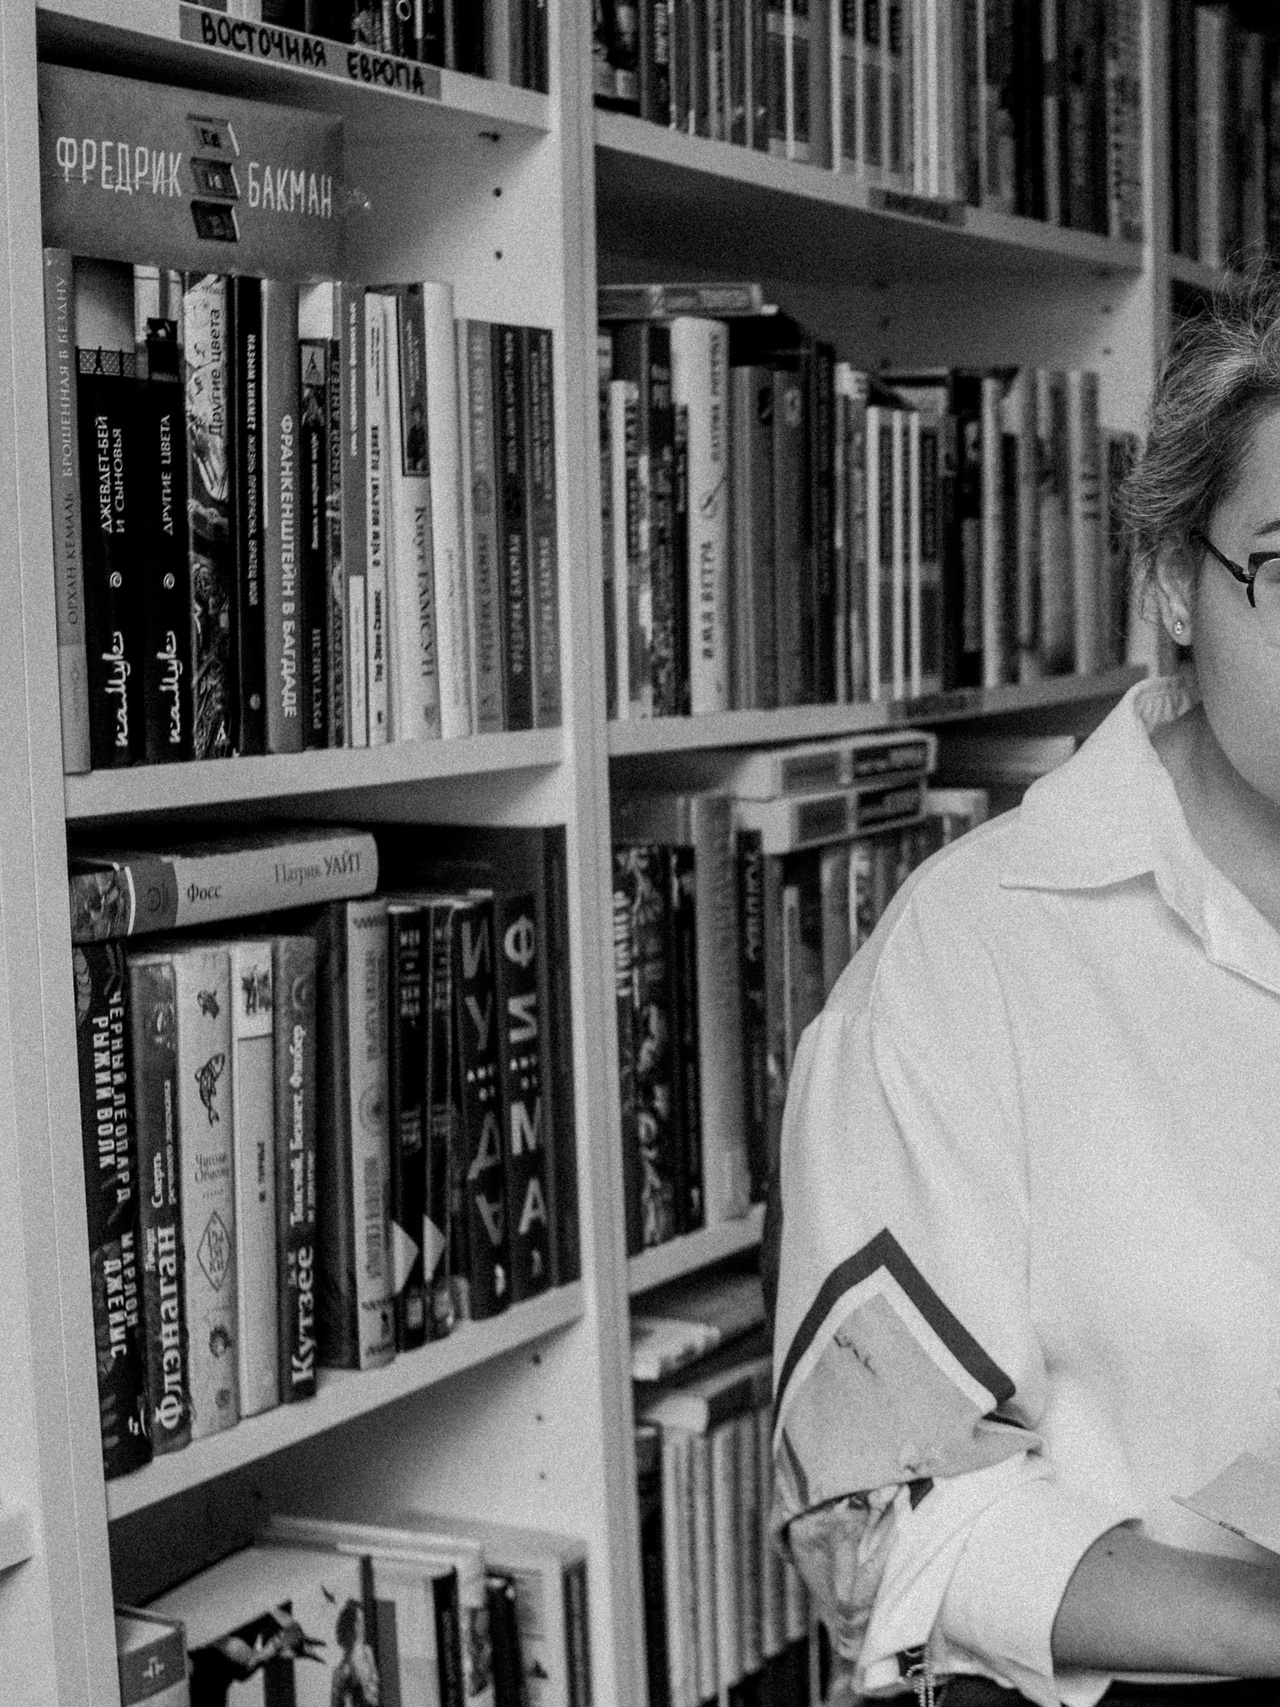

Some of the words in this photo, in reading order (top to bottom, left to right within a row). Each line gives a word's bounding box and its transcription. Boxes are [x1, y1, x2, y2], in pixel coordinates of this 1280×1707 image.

[201, 12, 327, 68] ВОСТОЧНАЯ
[346, 51, 424, 95] ЕВРОПА
[56, 136, 182, 197] ФРЕДРИК
[247, 161, 332, 218] БАКМАН
[55, 275, 70, 343] БЕЗДНУ
[208, 308, 223, 363] цвета
[57, 363, 74, 478] БРОШЕННАЯ
[159, 414, 174, 464] ЦВЕТА
[207, 367, 223, 437] Другие
[246, 381, 257, 430] ХИКМЕТ
[95, 415, 113, 534] ДЖЕВДЕТ-БЕЙ
[112, 427, 125, 512] СЫНОВЬЯ
[160, 471, 174, 536] ДРУГИЕ
[279, 414, 298, 597] ФРАНКЕНШТЕЙН
[63, 492, 77, 560] КЕМАЛЬ
[115, 518, 125, 533] И
[66, 566, 79, 625] ОРХАН
[281, 601, 295, 615] В
[279, 620, 298, 718] БАГДАДЕ
[186, 881, 223, 903] Фосс
[274, 862, 322, 886] Патрик
[322, 849, 363, 877] УАЙТ
[92, 1015, 115, 1101] РЫЖИЙ
[96, 1106, 116, 1170] ВОЛК
[113, 1092, 132, 1204] ЛЕОПАРД
[103, 1258, 128, 1359] ДЖЕЙМС
[120, 1231, 140, 1328] МАРЛОН
[290, 1245, 317, 1385] Кутзее
[153, 1223, 183, 1430] Флэнаган
